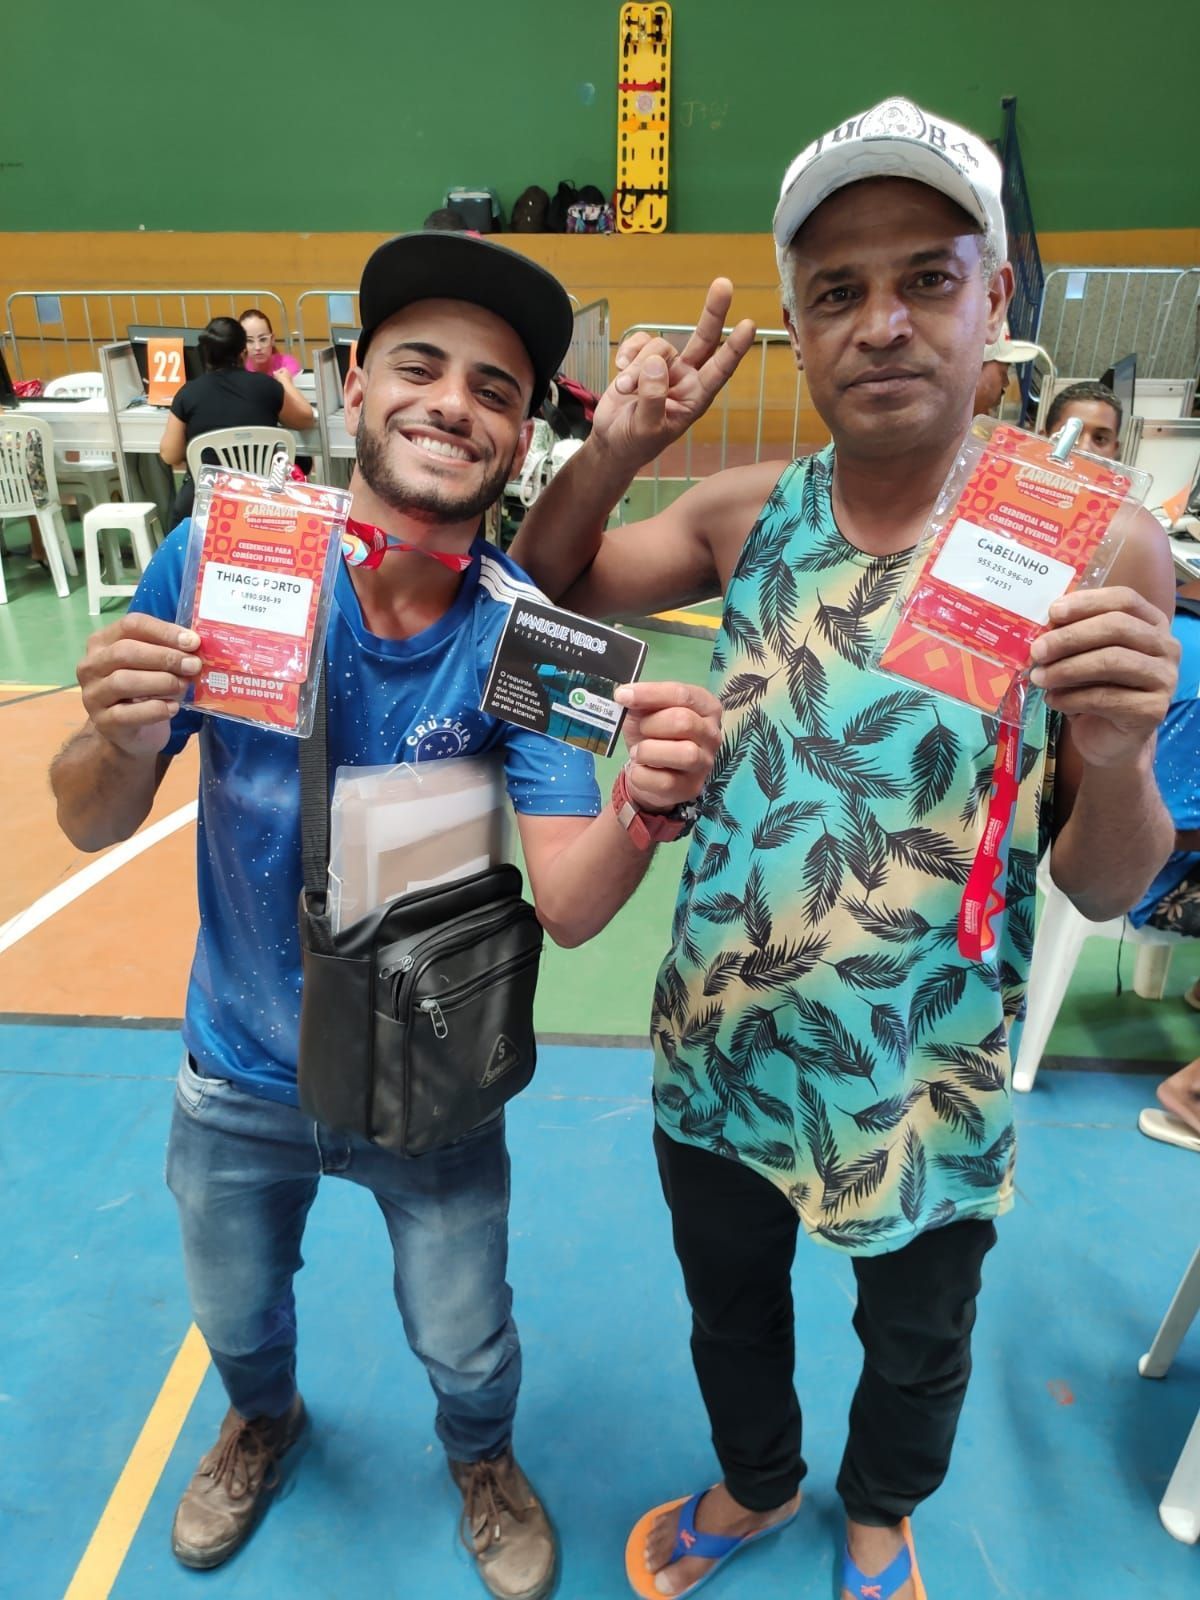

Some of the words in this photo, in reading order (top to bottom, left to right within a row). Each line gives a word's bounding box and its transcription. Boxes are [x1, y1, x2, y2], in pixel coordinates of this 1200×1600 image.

[153, 350, 181, 383] 22
[1016, 464, 1081, 495] CARNAVAL
[988, 512, 1023, 531] COMÉRCIO
[1023, 525, 1058, 545] EVENTUAL
[999, 505, 1038, 524] CREDENCIAL
[1038, 520, 1059, 533] PARA
[232, 549, 263, 561] COMÉRCIO
[264, 555, 294, 566] EVENTUAL
[238, 542, 273, 552] CREDENCIAL
[274, 546, 291, 554] PARA
[976, 537, 1050, 575] CABELINHO
[215, 570, 260, 587] THIAGO
[263, 578, 301, 594] PORTO
[984, 574, 1012, 591] 474751
[513, 628, 583, 657] VIDRAÇARIA
[515, 611, 569, 640] NANUQUE
[569, 630, 607, 654] VIDROS
[230, 685, 244, 694] NA
[245, 687, 283, 700] MARQUE
[505, 673, 533, 688] requinte
